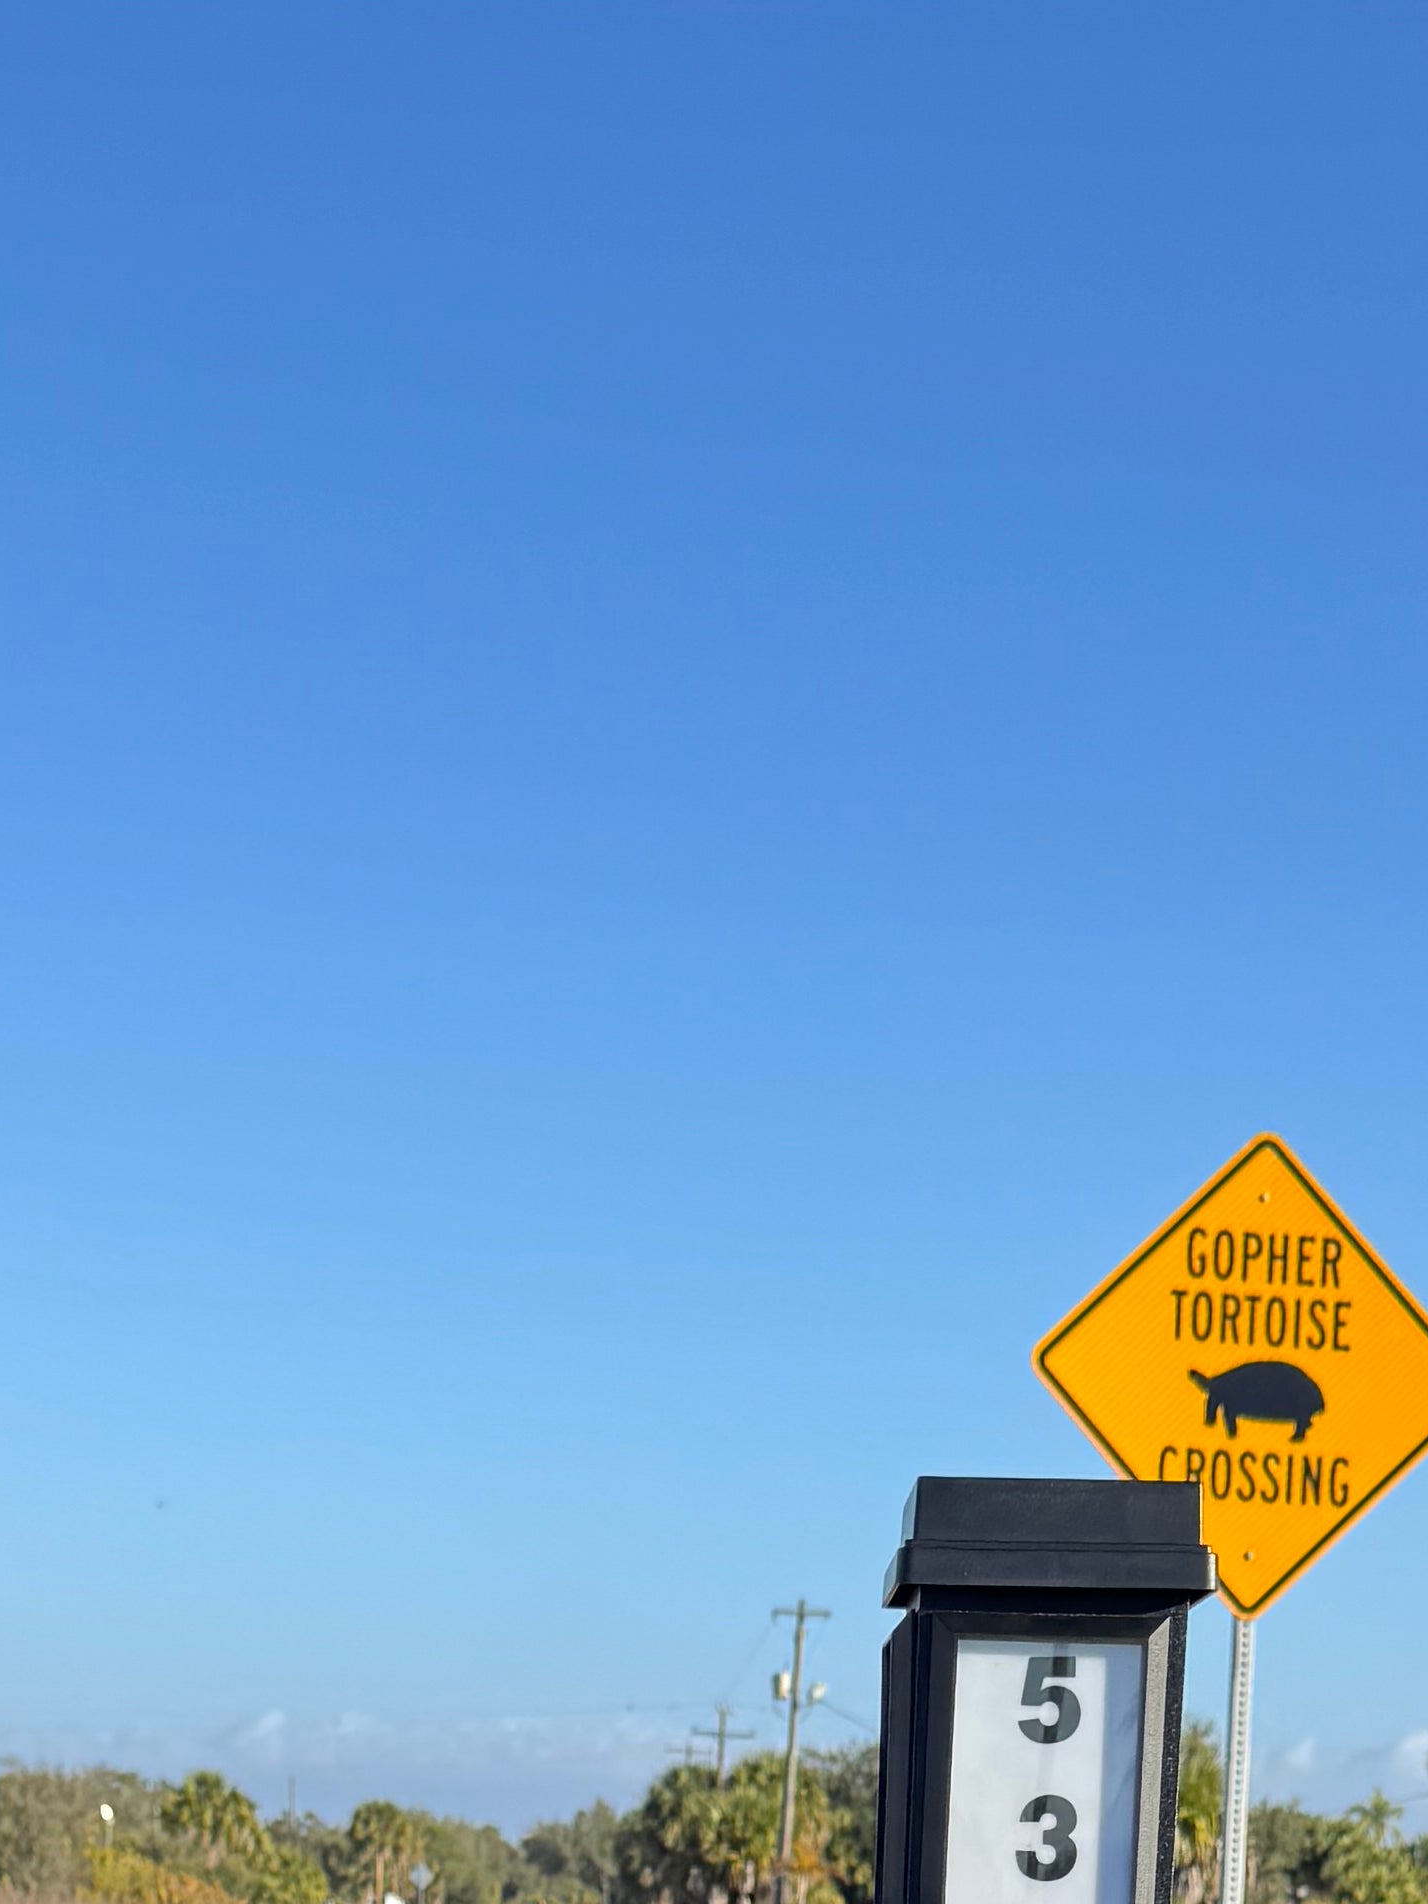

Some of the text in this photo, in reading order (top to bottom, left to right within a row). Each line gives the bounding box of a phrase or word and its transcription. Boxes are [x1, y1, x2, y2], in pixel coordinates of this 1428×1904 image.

[1186, 1226, 1343, 1290] GOPHER
[1170, 1289, 1351, 1352] TORTOISE
[1158, 1445, 1350, 1508] CROSSING
